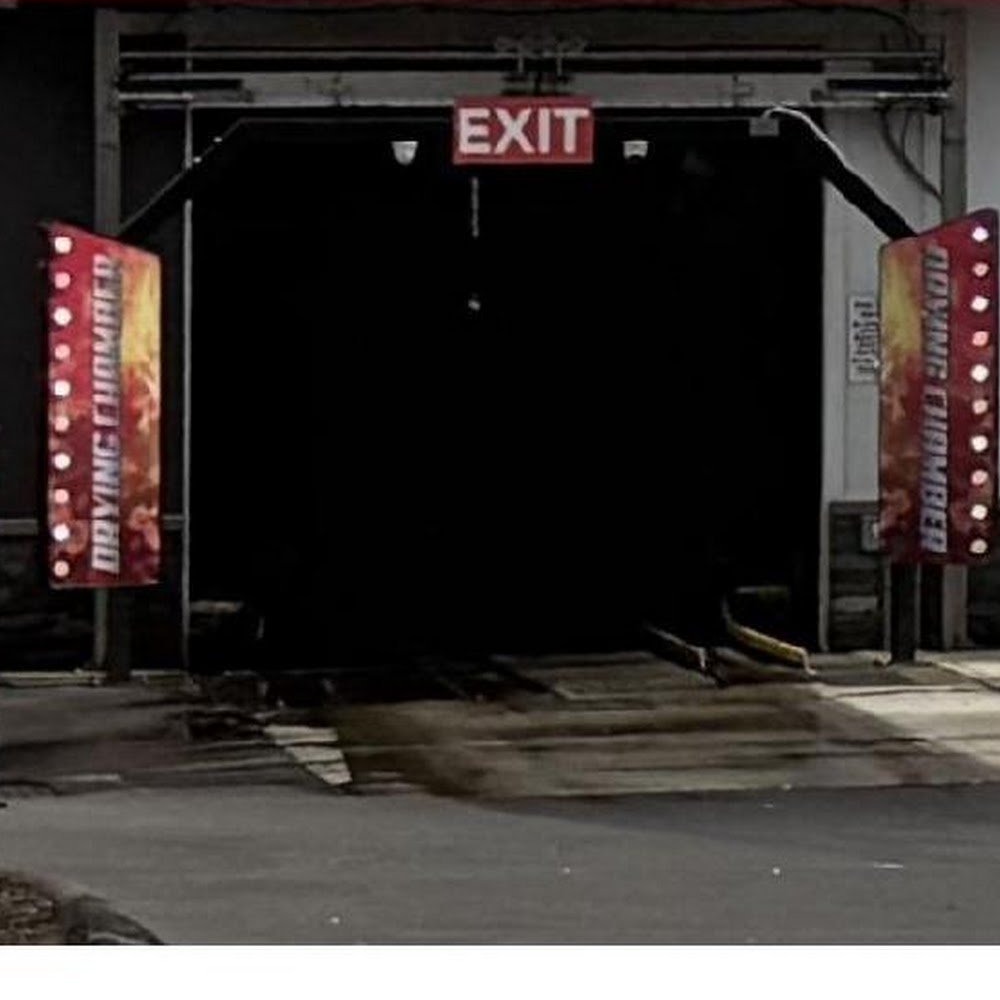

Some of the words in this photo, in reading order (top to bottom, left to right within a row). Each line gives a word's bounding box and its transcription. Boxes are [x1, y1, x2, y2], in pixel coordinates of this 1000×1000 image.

[458, 107, 591, 154] EXIT
[92, 254, 122, 426] CHAMBER
[91, 430, 120, 575] DRYING
[920, 383, 949, 553] CHAMBER
